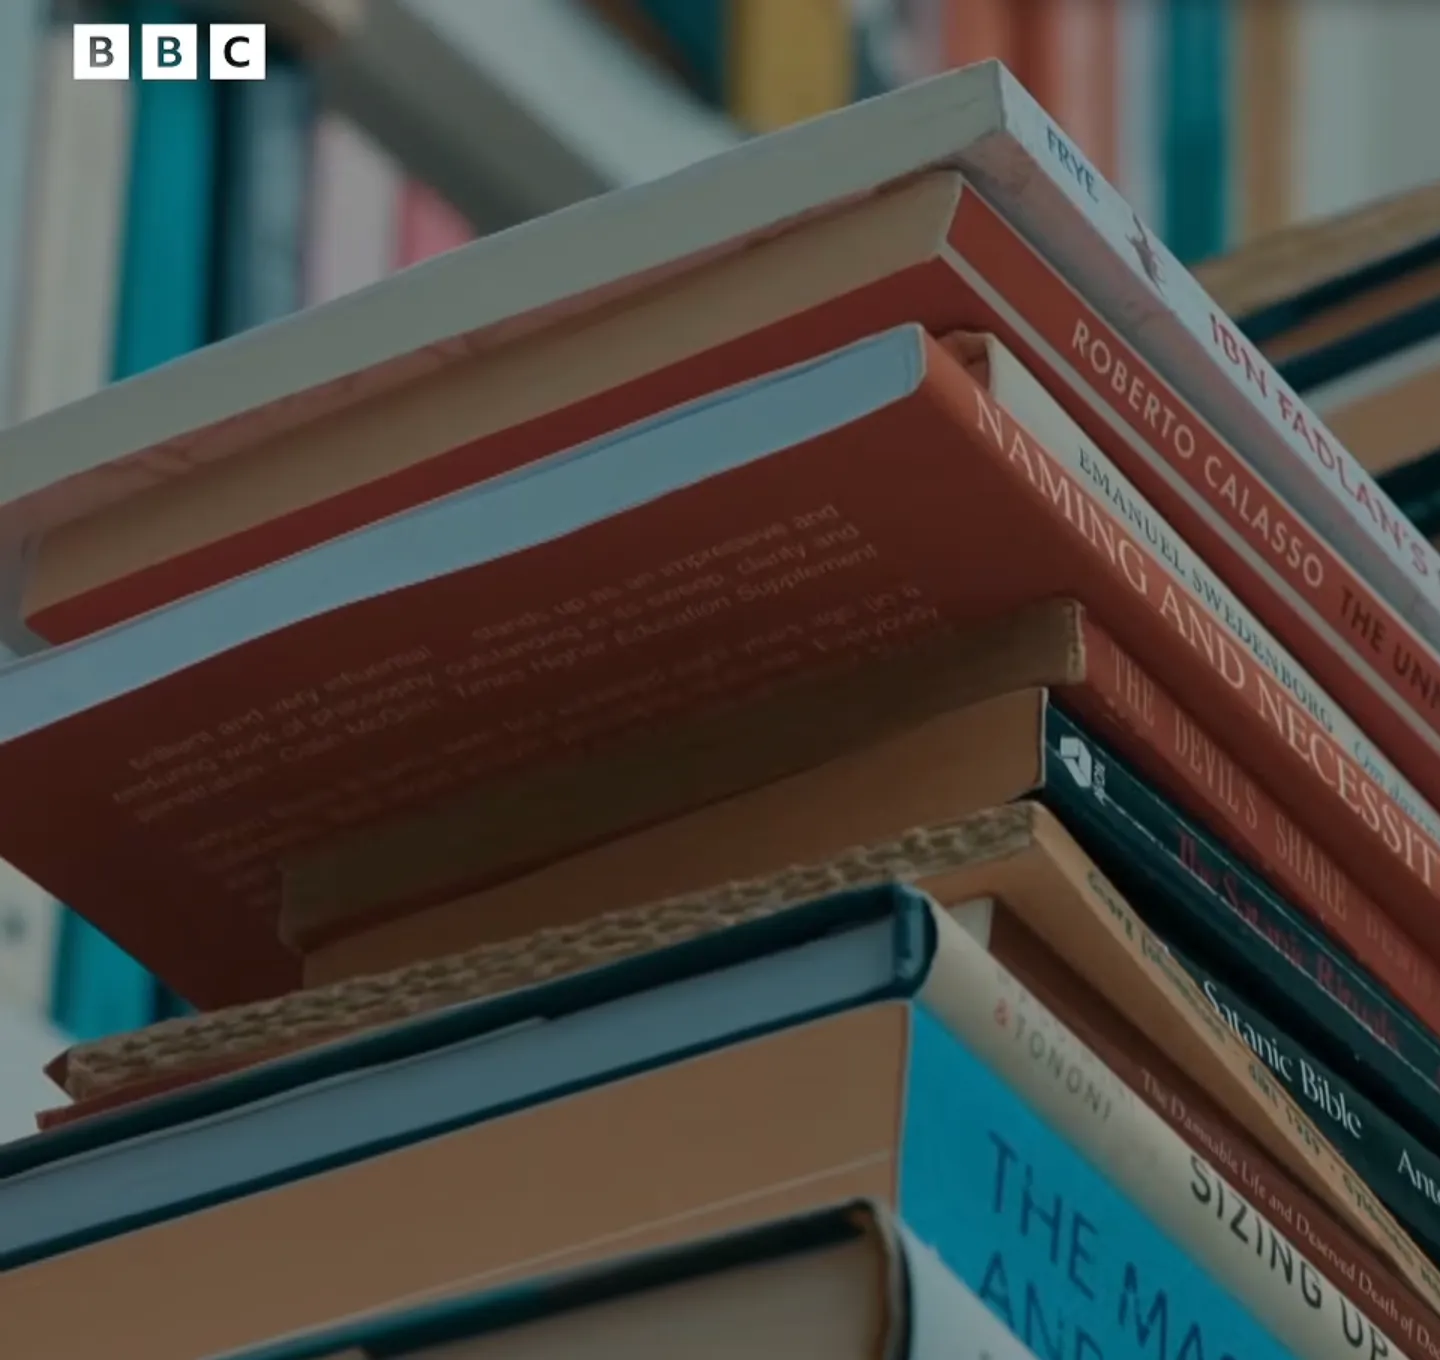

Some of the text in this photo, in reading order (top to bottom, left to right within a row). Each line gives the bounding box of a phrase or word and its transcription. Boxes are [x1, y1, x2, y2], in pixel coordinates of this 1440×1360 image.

[1047, 125, 1098, 203] FRYE
[812, 520, 862, 550] and
[974, 388, 1148, 596] NAMING
[1159, 583, 1246, 691] AND
[1072, 319, 1195, 460] ROBERTO
[1204, 455, 1324, 588] CALASSO
[1340, 586, 1386, 653] THE
[1210, 313, 1267, 398] IBN
[1277, 389, 1429, 577] FADLAN'S
[450, 667, 527, 700] Times
[529, 640, 607, 674] Higher
[613, 596, 733, 648] Education
[735, 542, 879, 602] Supplement
[470, 611, 552, 642] stands
[657, 520, 790, 578] impressive
[790, 502, 841, 531] and
[1078, 446, 1334, 734] EMANUEL SWEDENBORG
[1111, 644, 1156, 729] THE
[1173, 703, 1259, 831] DEVIL'S
[1274, 811, 1347, 923] SHARE
[1014, 1013, 1113, 1122] TONONI
[1203, 979, 1293, 1083] Satanic
[1299, 1057, 1363, 1141] Bible
[985, 1128, 1098, 1301] THE
[1140, 1067, 1168, 1111] The
[1171, 1094, 1239, 1176] Damnable
[1241, 1159, 1267, 1200] Life
[1267, 1194, 1294, 1227] and
[1296, 1211, 1356, 1282] Deserved
[1358, 1268, 1399, 1323] Death
[1400, 1314, 1414, 1341] of
[1189, 1153, 1323, 1310] SIZING
[1338, 1295, 1390, 1360] UP
